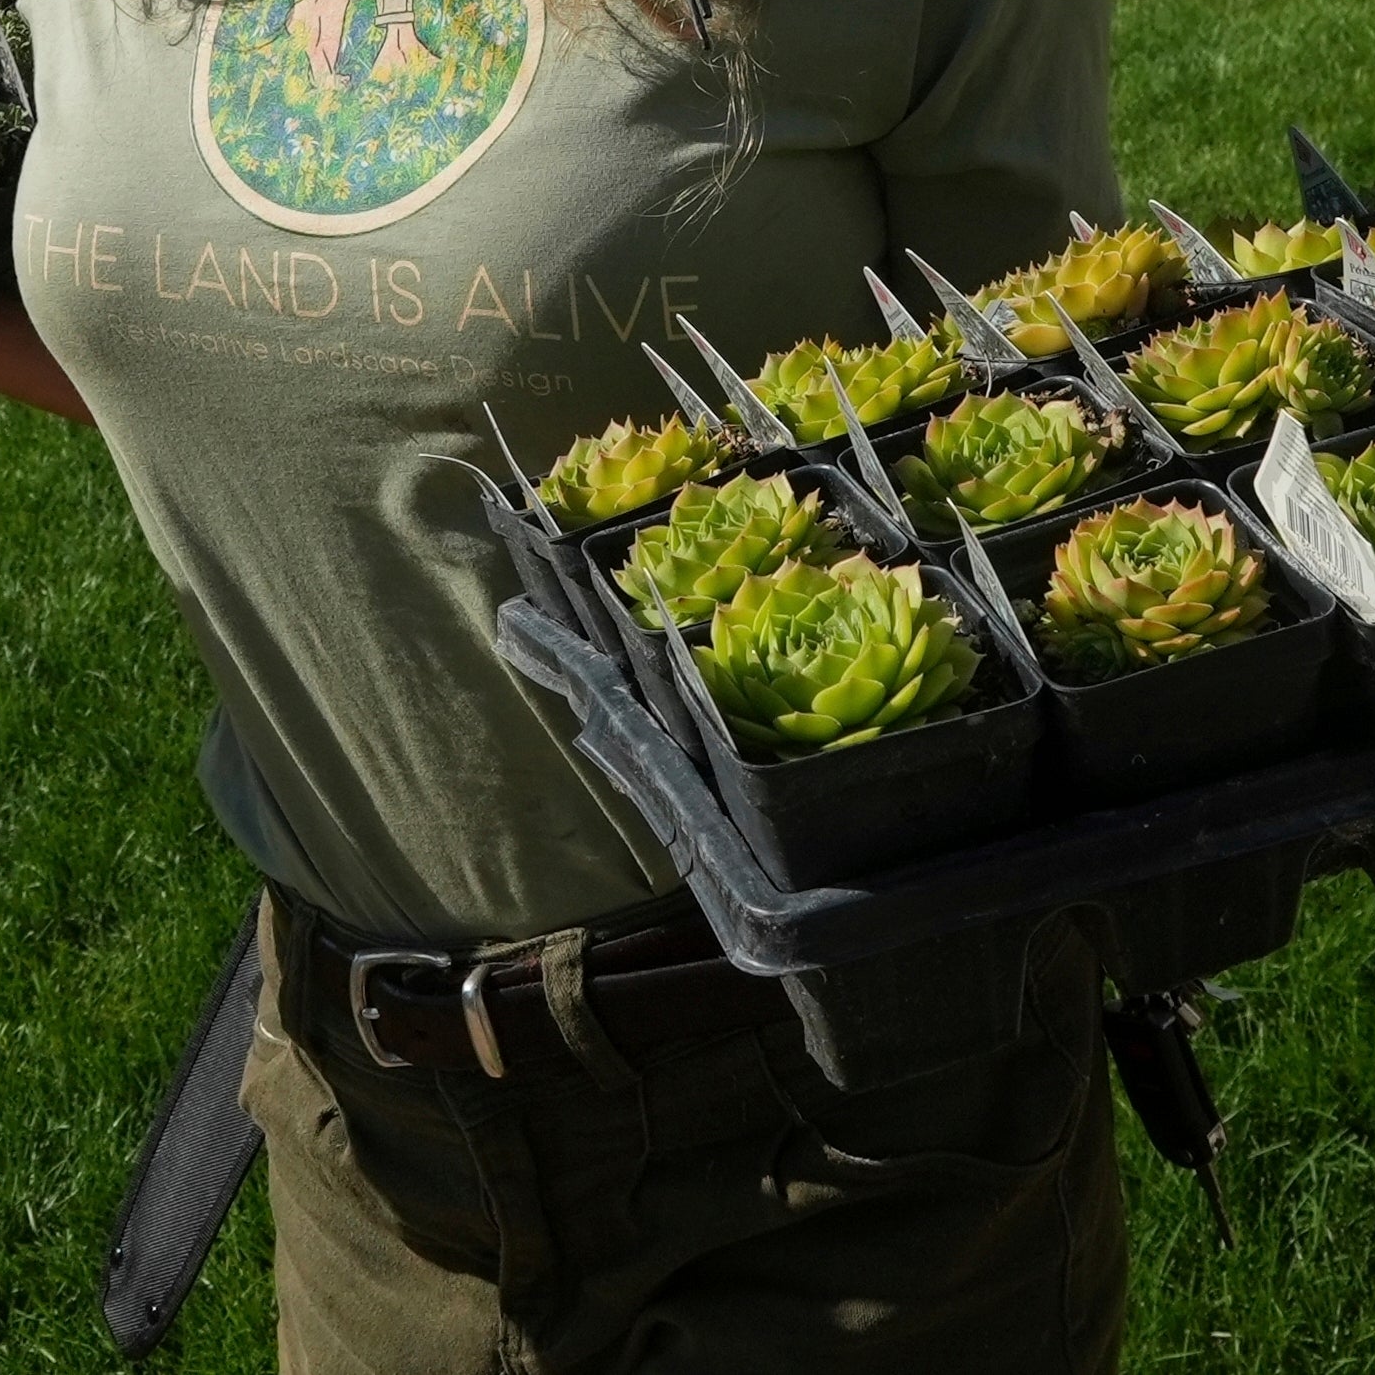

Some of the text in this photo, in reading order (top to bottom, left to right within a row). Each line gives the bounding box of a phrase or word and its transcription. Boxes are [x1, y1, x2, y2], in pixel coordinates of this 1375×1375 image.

[24, 214, 699, 343] THE LAND IS ALIVE
[450, 355, 574, 396] Design
